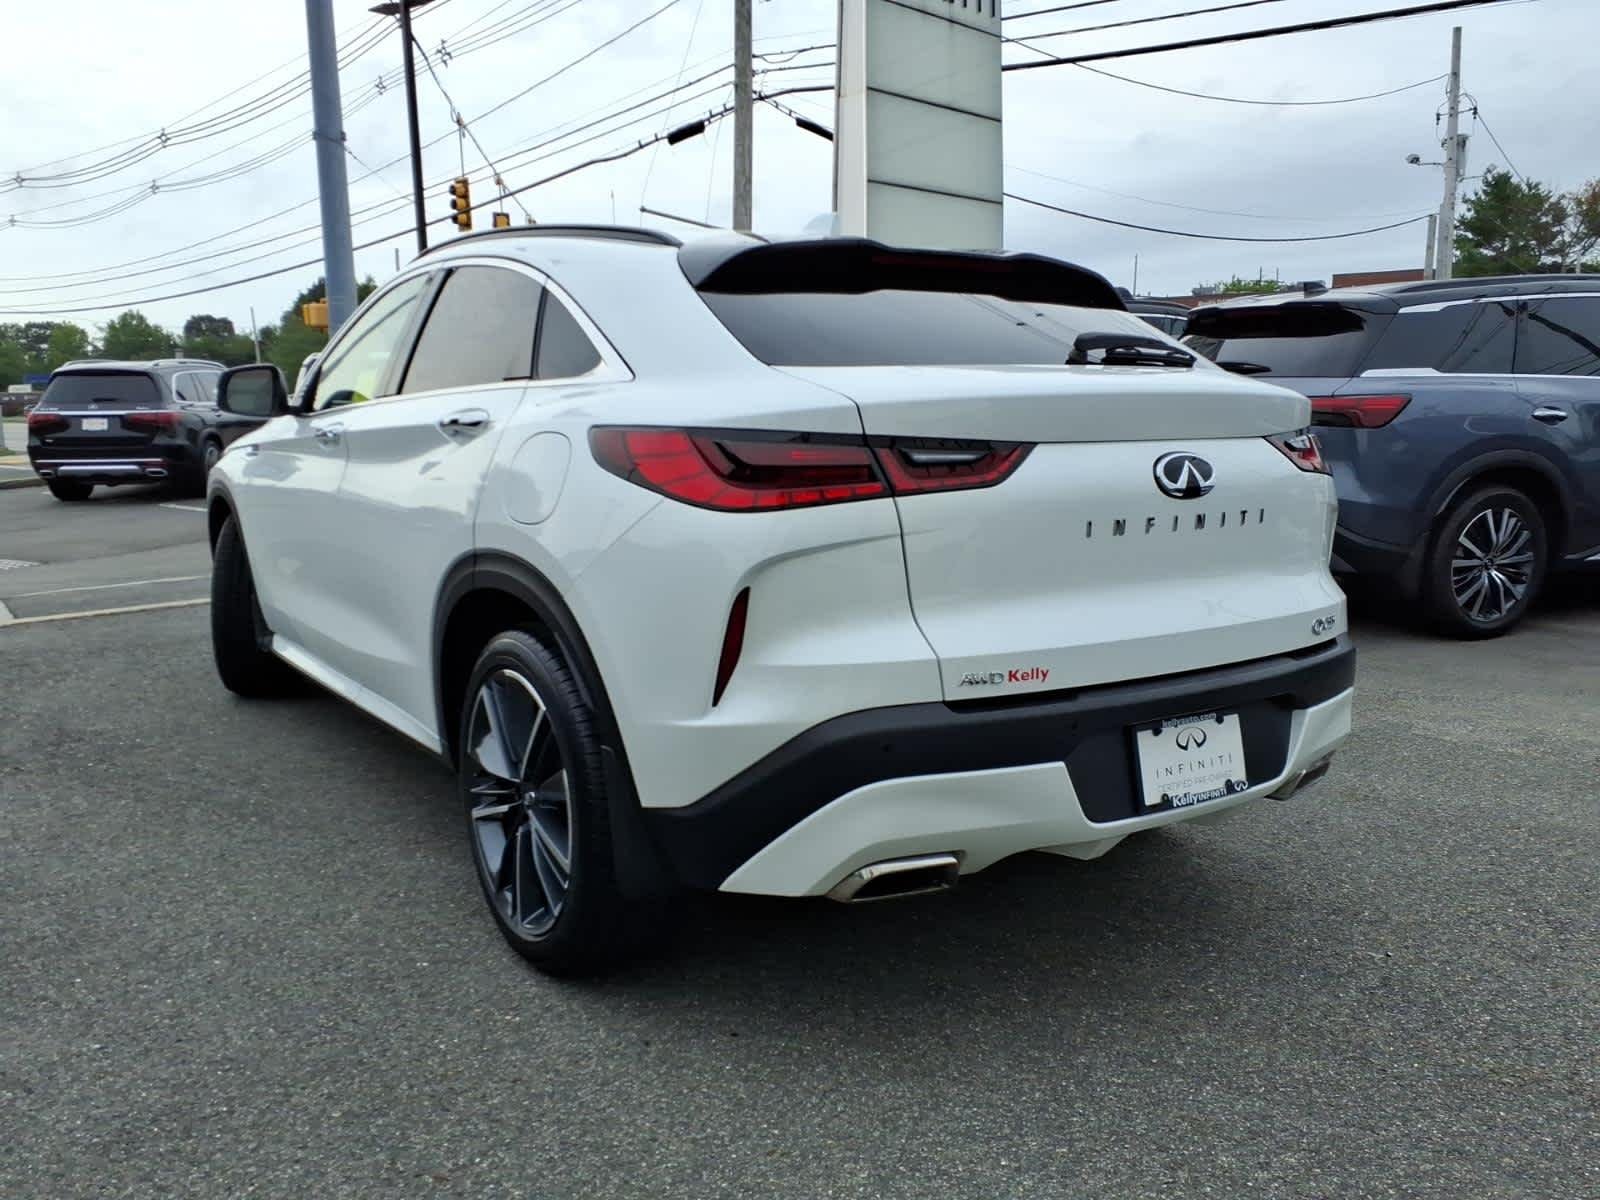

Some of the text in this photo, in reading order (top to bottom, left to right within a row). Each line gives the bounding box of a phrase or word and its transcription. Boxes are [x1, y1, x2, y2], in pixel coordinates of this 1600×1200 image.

[1085, 508, 1265, 539] INFINITI
[958, 667, 1050, 687] AWD Kelly
[1155, 752, 1233, 778] INFINITI
